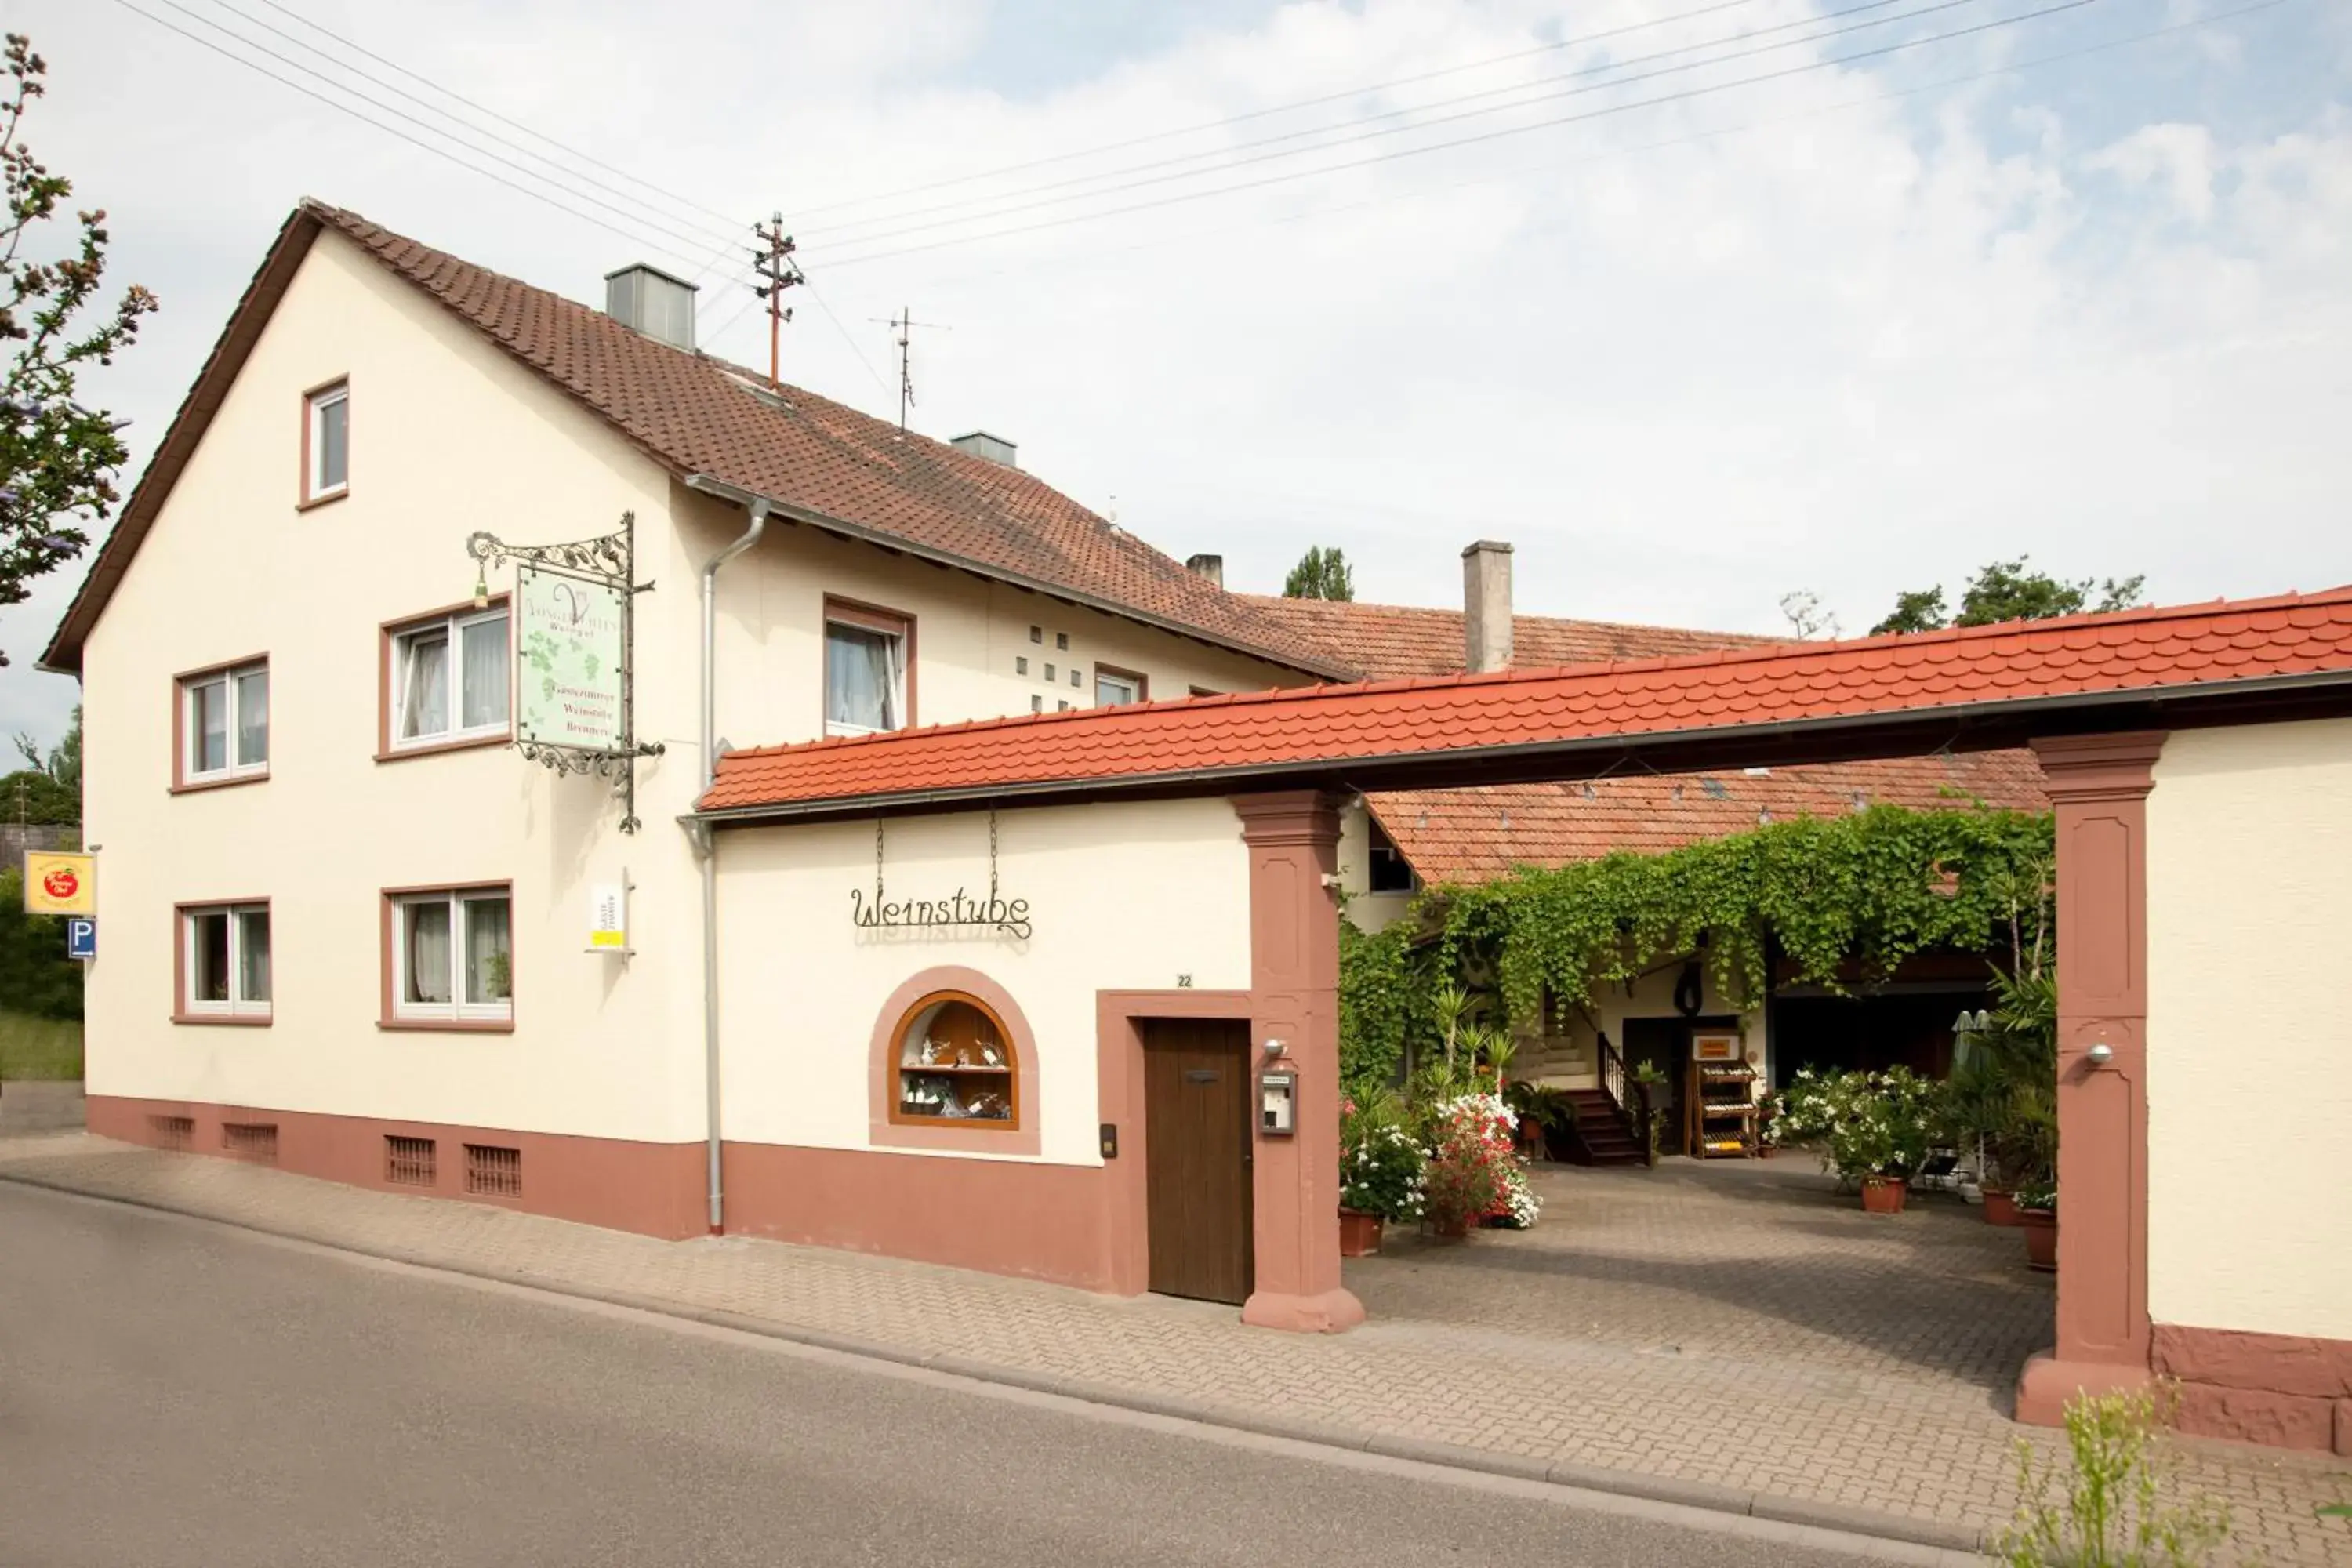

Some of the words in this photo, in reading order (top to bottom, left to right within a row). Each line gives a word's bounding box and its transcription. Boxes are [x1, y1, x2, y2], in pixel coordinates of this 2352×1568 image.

[851, 882, 1032, 933] Weinstube
[74, 922, 92, 946] P
[1178, 975, 1192, 987] 22
